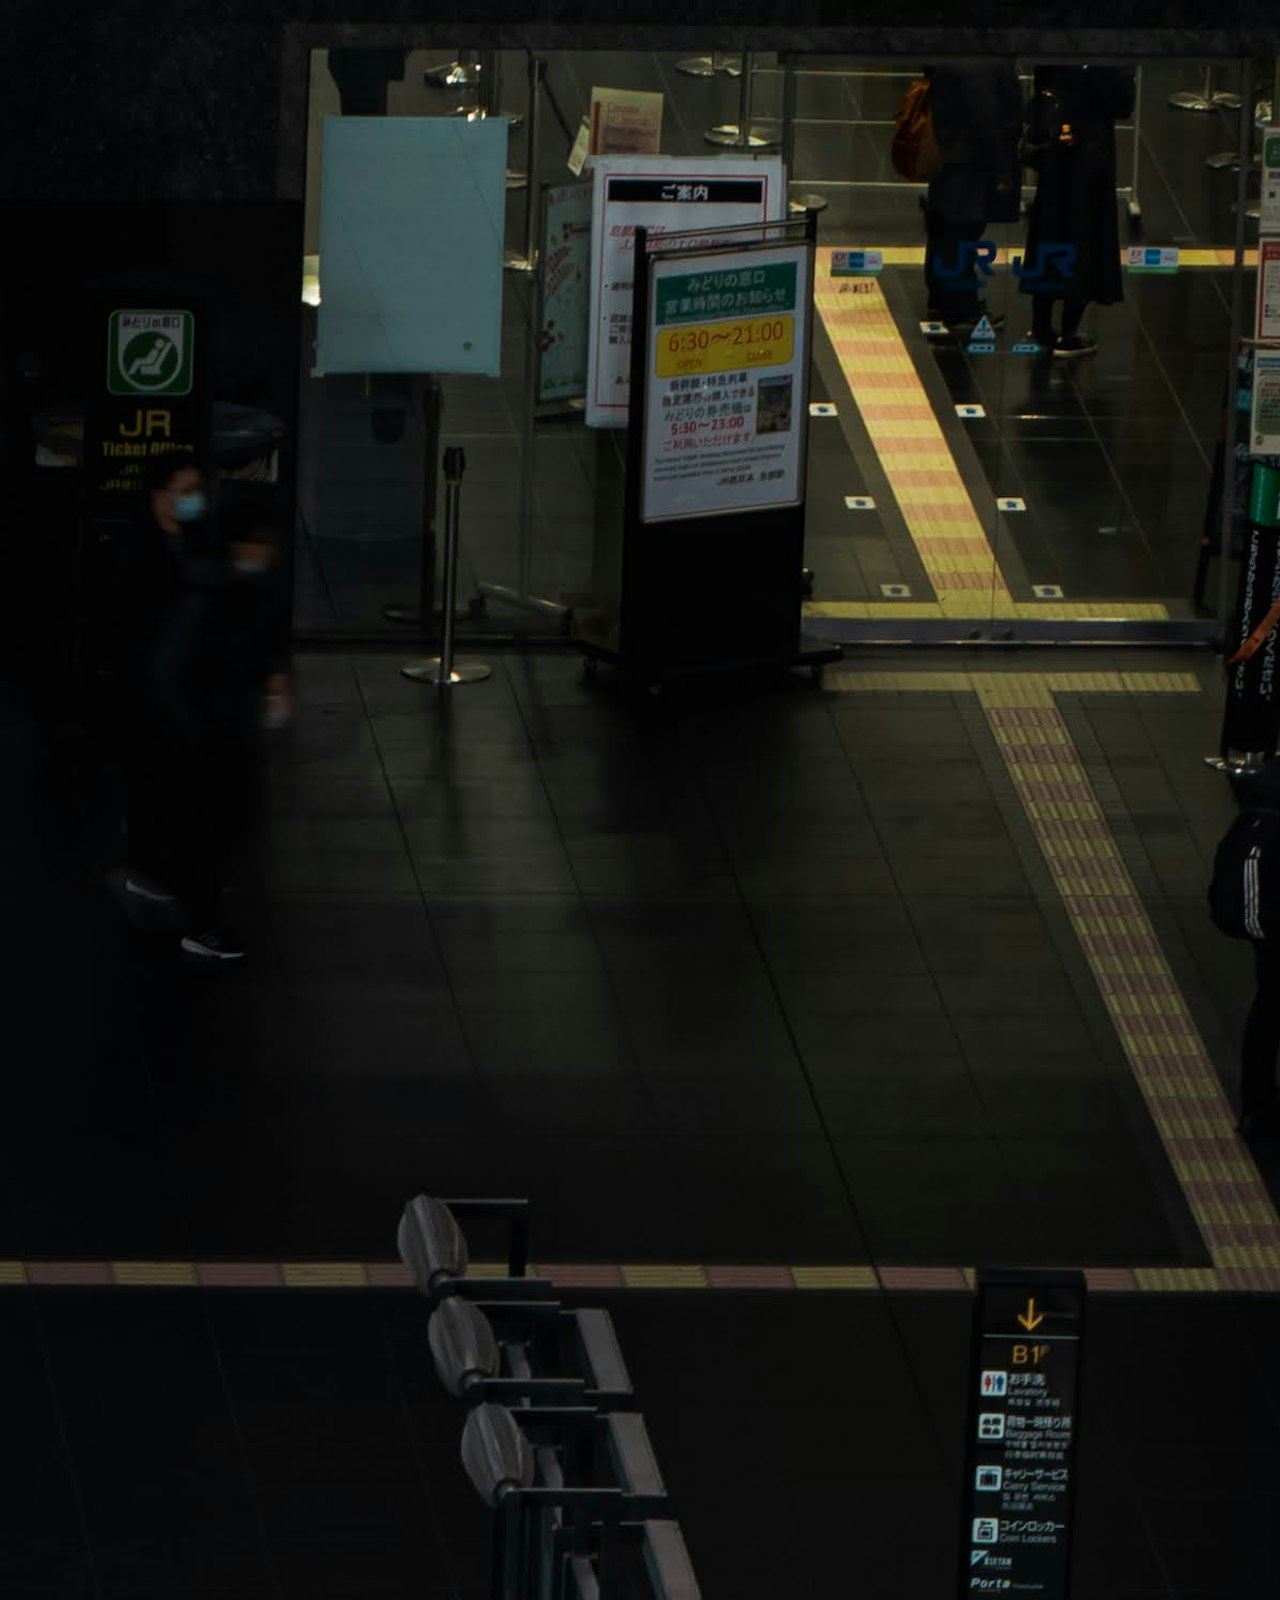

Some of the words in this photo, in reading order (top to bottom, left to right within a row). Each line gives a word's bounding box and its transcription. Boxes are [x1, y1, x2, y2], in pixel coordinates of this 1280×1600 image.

[660, 184, 709, 201] ご案内
[931, 239, 996, 280] JR
[1012, 239, 1080, 281] JR
[687, 270, 766, 292] みどりの窓口
[118, 408, 172, 438] JR
[1000, 1520, 1065, 1532] コインロッカー
[969, 1577, 1011, 1590] Porta
